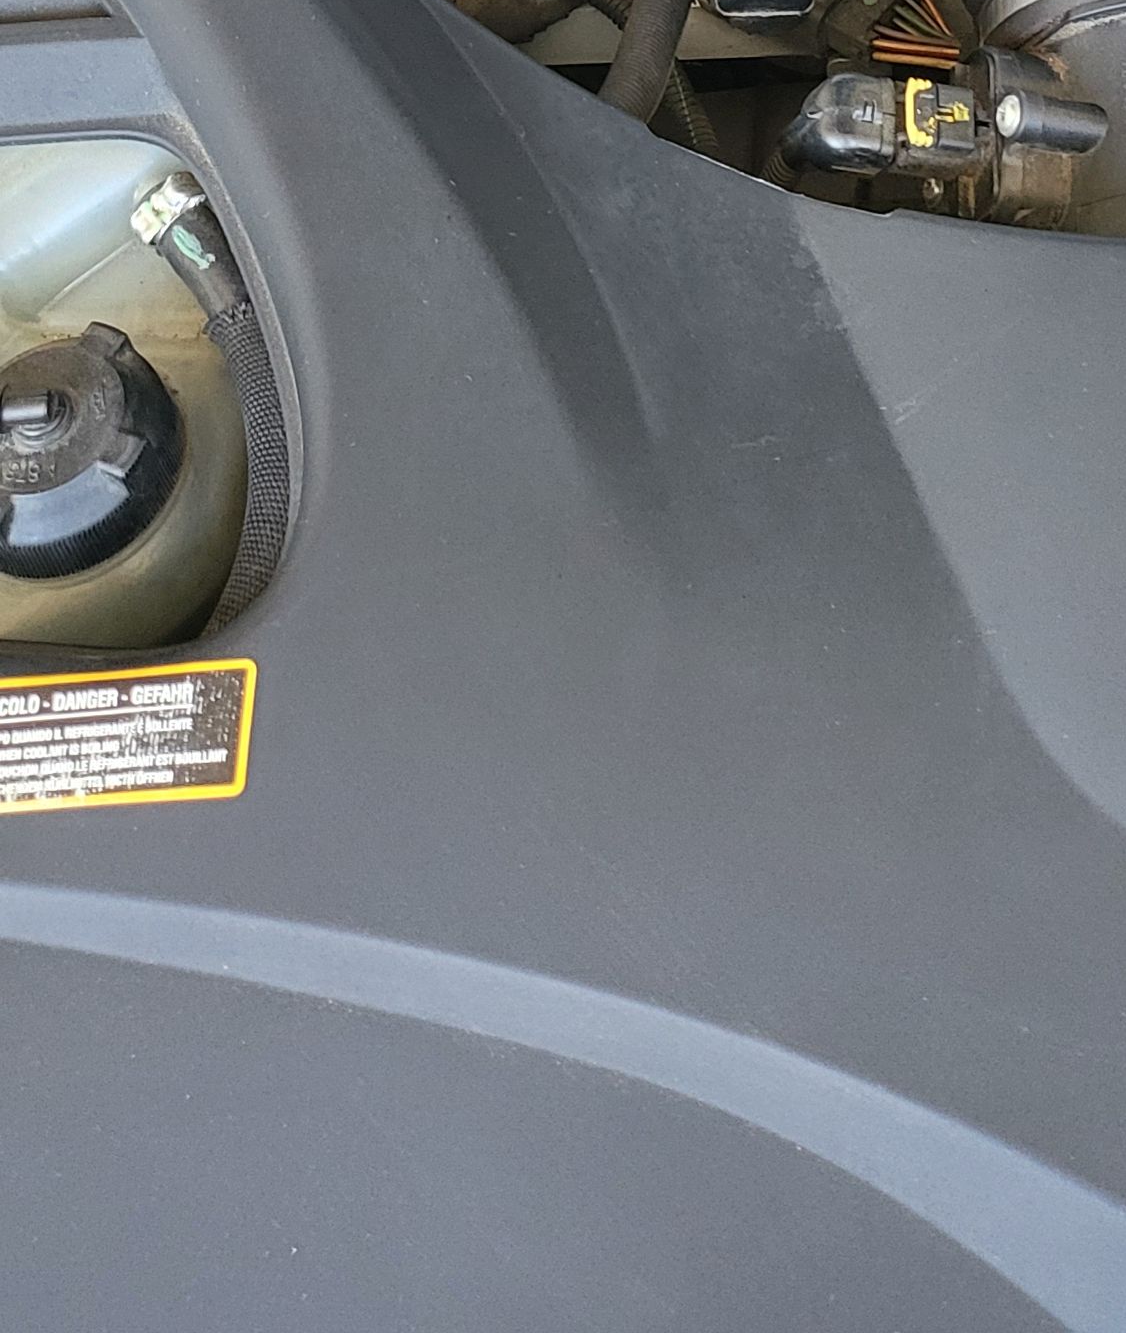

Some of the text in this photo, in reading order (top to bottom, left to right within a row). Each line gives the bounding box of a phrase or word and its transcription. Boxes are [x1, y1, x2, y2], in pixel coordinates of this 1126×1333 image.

[52, 687, 119, 712] DANGER
[131, 681, 195, 706] GEFAHR
[11, 727, 53, 745] QUANDO
[144, 716, 194, 733] BOLLENTE
[22, 744, 68, 760] COOLANT
[69, 743, 80, 756] IS
[80, 738, 120, 755] BOILING
[76, 758, 89, 772] LE
[155, 748, 174, 766] EST
[174, 747, 228, 765] BOUILLANT
